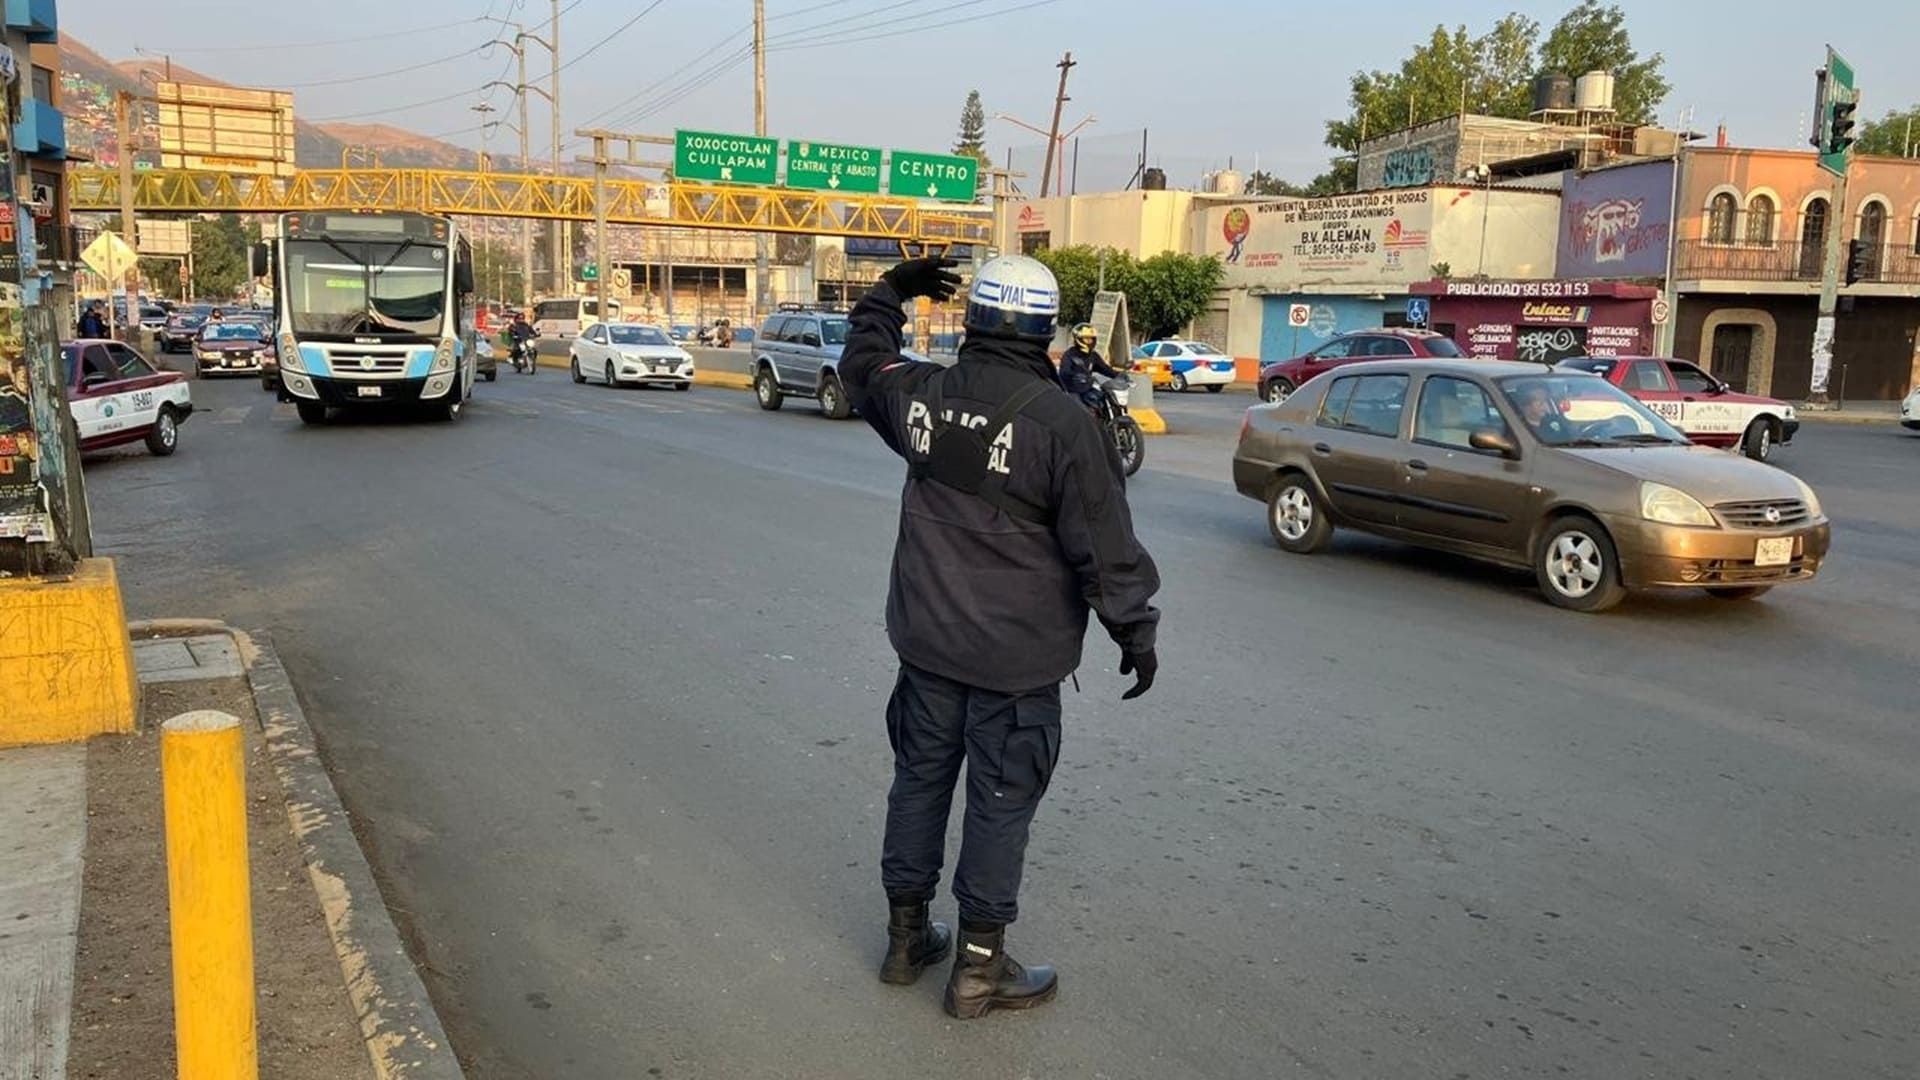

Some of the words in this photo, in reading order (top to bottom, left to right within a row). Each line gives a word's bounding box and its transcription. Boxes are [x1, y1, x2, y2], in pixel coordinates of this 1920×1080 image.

[685, 136, 771, 155] XOXOCOTLAN
[819, 146, 870, 161] MEXICO
[688, 151, 766, 169] CUILAPAM
[791, 159, 828, 173] CENTRAL
[832, 163, 842, 174] DE
[846, 164, 877, 177] ABASTO
[900, 160, 967, 180] CENTRO
[1307, 198, 1333, 210] BUENA
[1336, 196, 1379, 208] VOLUNTAD
[1382, 195, 1393, 205] 24
[1396, 192, 1428, 204] HORAS
[1285, 213, 1295, 223] DE
[1000, 284, 1025, 306] VIAL
[1447, 283, 1520, 295] PUBLICIDAD
[1541, 283, 1561, 296] 532
[1574, 283, 1589, 295] 53
